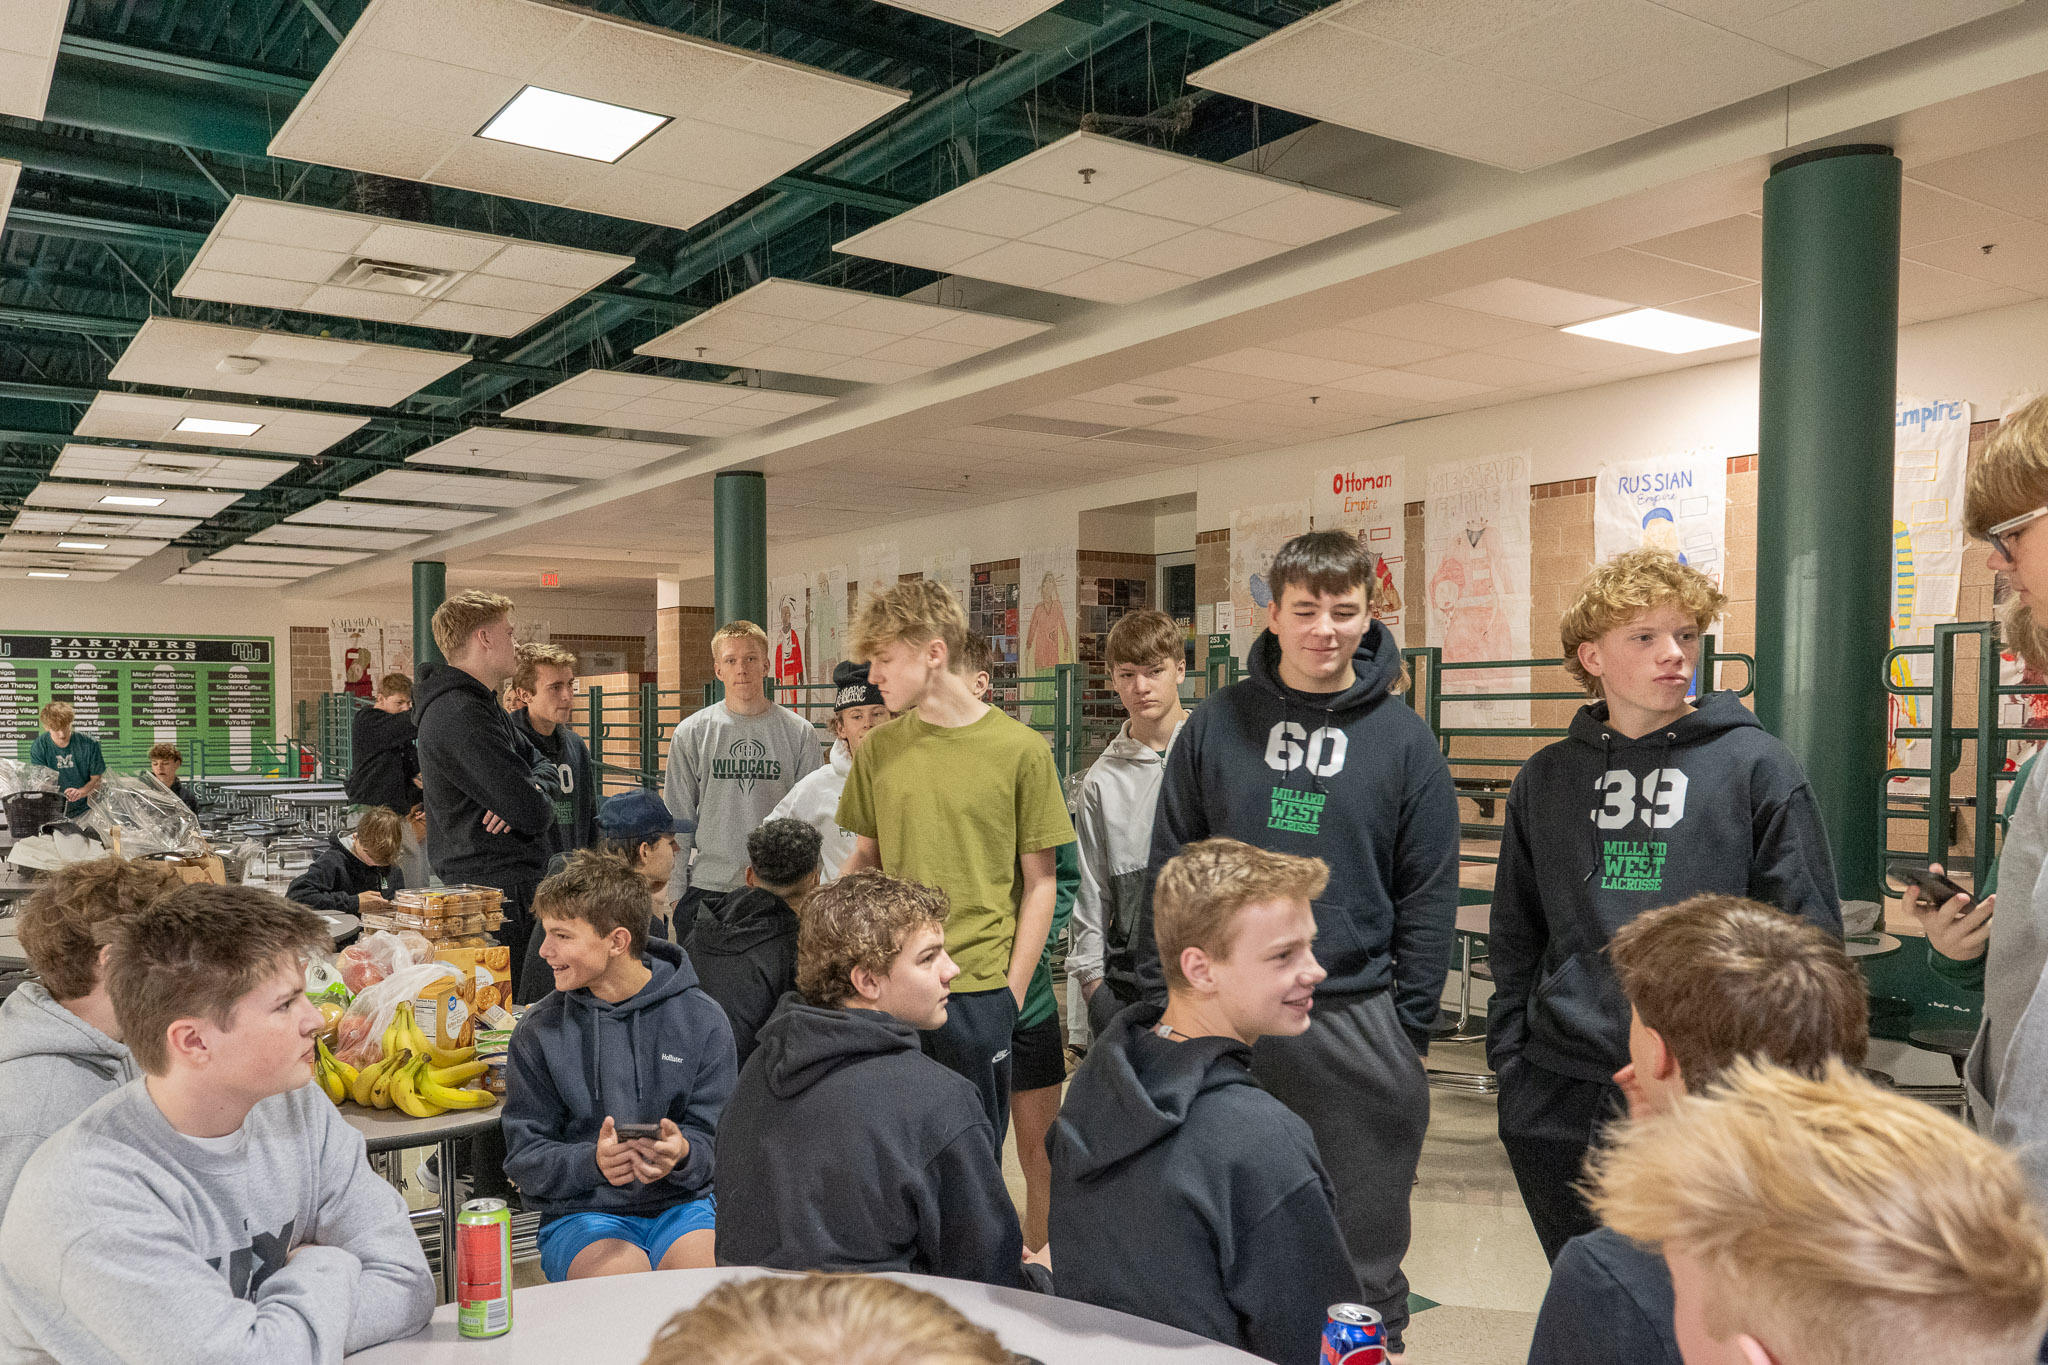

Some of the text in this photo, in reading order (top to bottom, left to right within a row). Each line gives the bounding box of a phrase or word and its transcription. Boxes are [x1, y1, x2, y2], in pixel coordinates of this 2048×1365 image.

[1333, 472, 1392, 494] Ottoman
[1618, 470, 1693, 495] RUSSIAN
[1344, 497, 1378, 514] Empire
[542, 574, 558, 586] EXIT
[1175, 617, 1191, 627] SAFE
[50, 638, 196, 649] PARTNERS
[1209, 636, 1220, 644] 253
[50, 650, 196, 660] EDUCATION
[1264, 721, 1349, 777] 60
[713, 759, 781, 775] WILDCATS
[1271, 786, 1326, 806] MILLARD
[1590, 768, 1689, 829] 39
[1271, 799, 1324, 823] WEST
[1267, 817, 1321, 835] LACROSSE
[1603, 841, 1668, 856] MILLARD
[1603, 855, 1666, 878] WEST
[1600, 877, 1663, 891] LACROSSE
